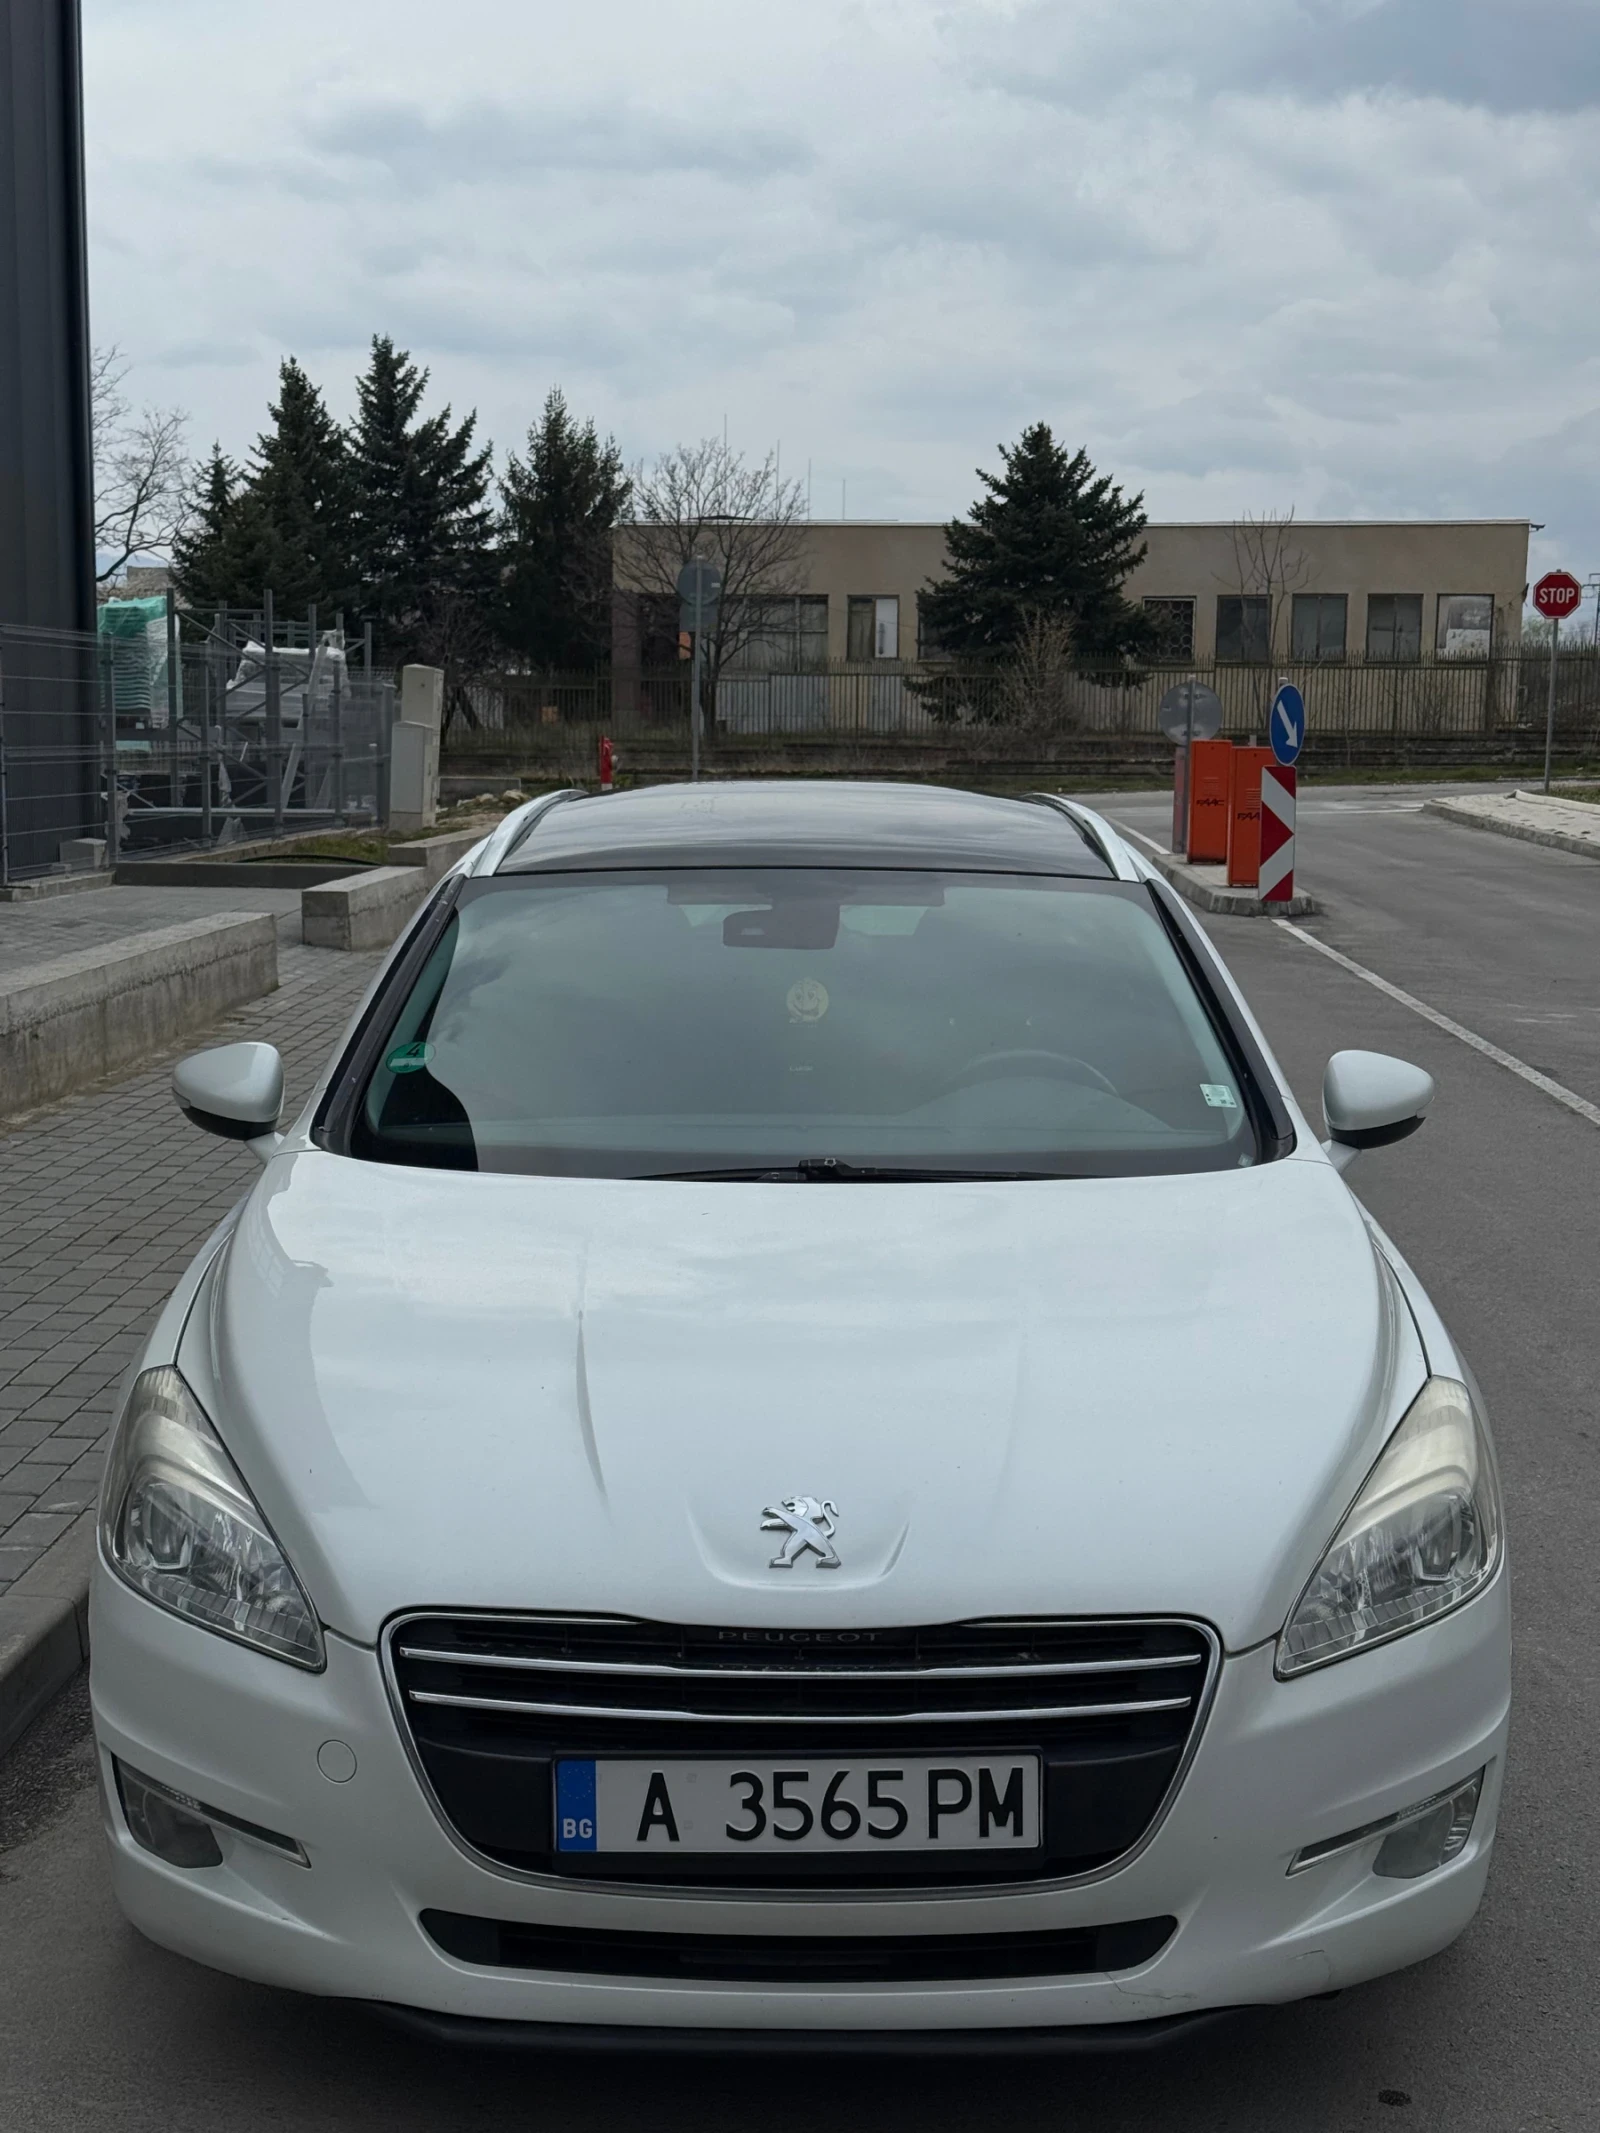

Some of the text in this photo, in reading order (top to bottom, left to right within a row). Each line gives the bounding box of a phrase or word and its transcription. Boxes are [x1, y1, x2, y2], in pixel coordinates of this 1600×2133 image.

[1539, 587, 1575, 604] STOP
[1196, 798, 1225, 807] FAAC
[1237, 812, 1260, 821] FAA
[406, 1043, 421, 1056] 4
[718, 1631, 882, 1642] PEUGEOT
[636, 1767, 1024, 1842] A 3565 PM
[562, 1817, 594, 1839] BG
